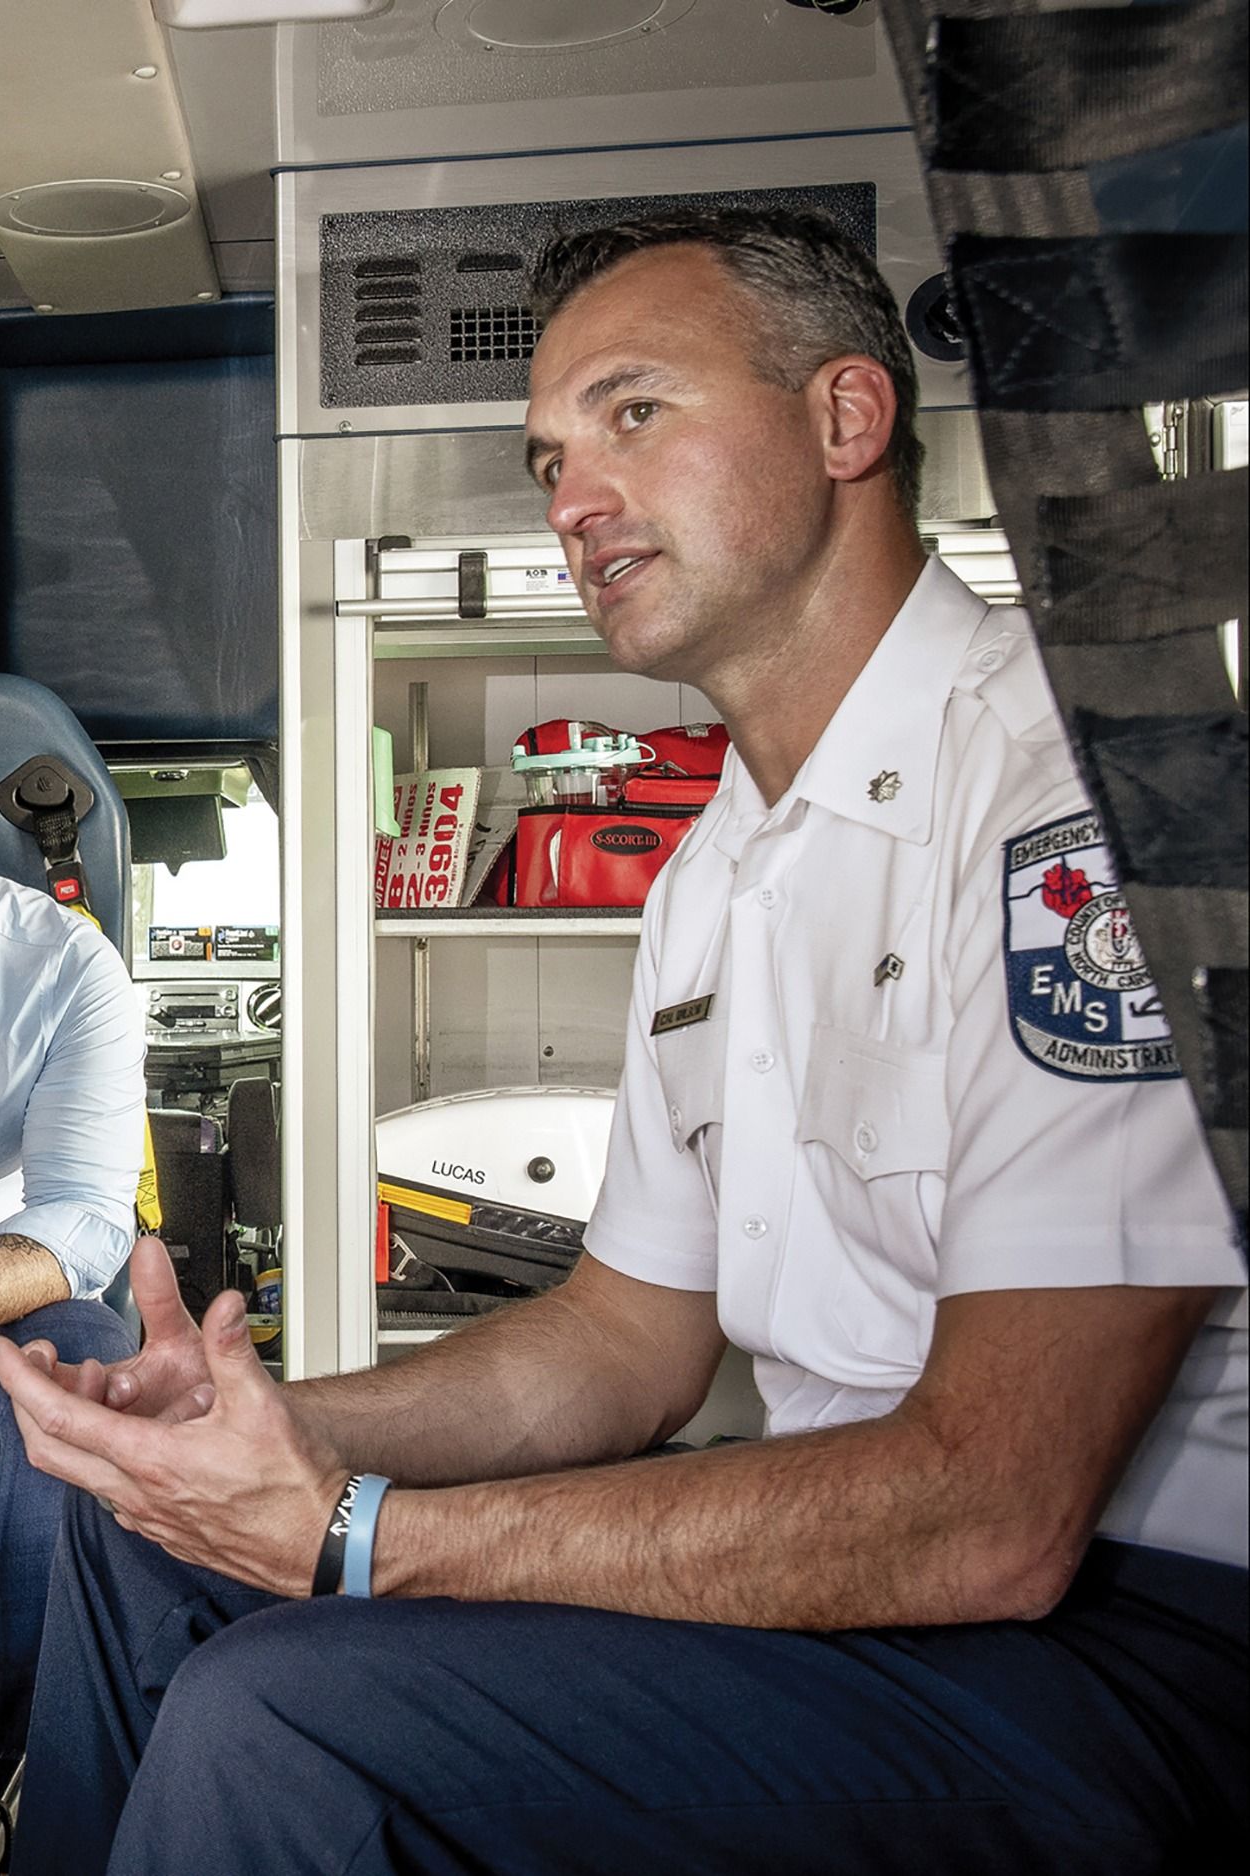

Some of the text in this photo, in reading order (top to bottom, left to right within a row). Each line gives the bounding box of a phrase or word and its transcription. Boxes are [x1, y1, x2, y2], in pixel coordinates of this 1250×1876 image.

[397, 843, 408, 857] 2
[1014, 820, 1100, 866] EMERGENCY
[406, 872, 424, 907] 2
[415, 842, 426, 856] 3
[1067, 901, 1102, 945] COUNTY
[1070, 952, 1109, 985] NORTH
[1031, 965, 1109, 1032] EMS
[432, 1160, 486, 1185] LUCAS
